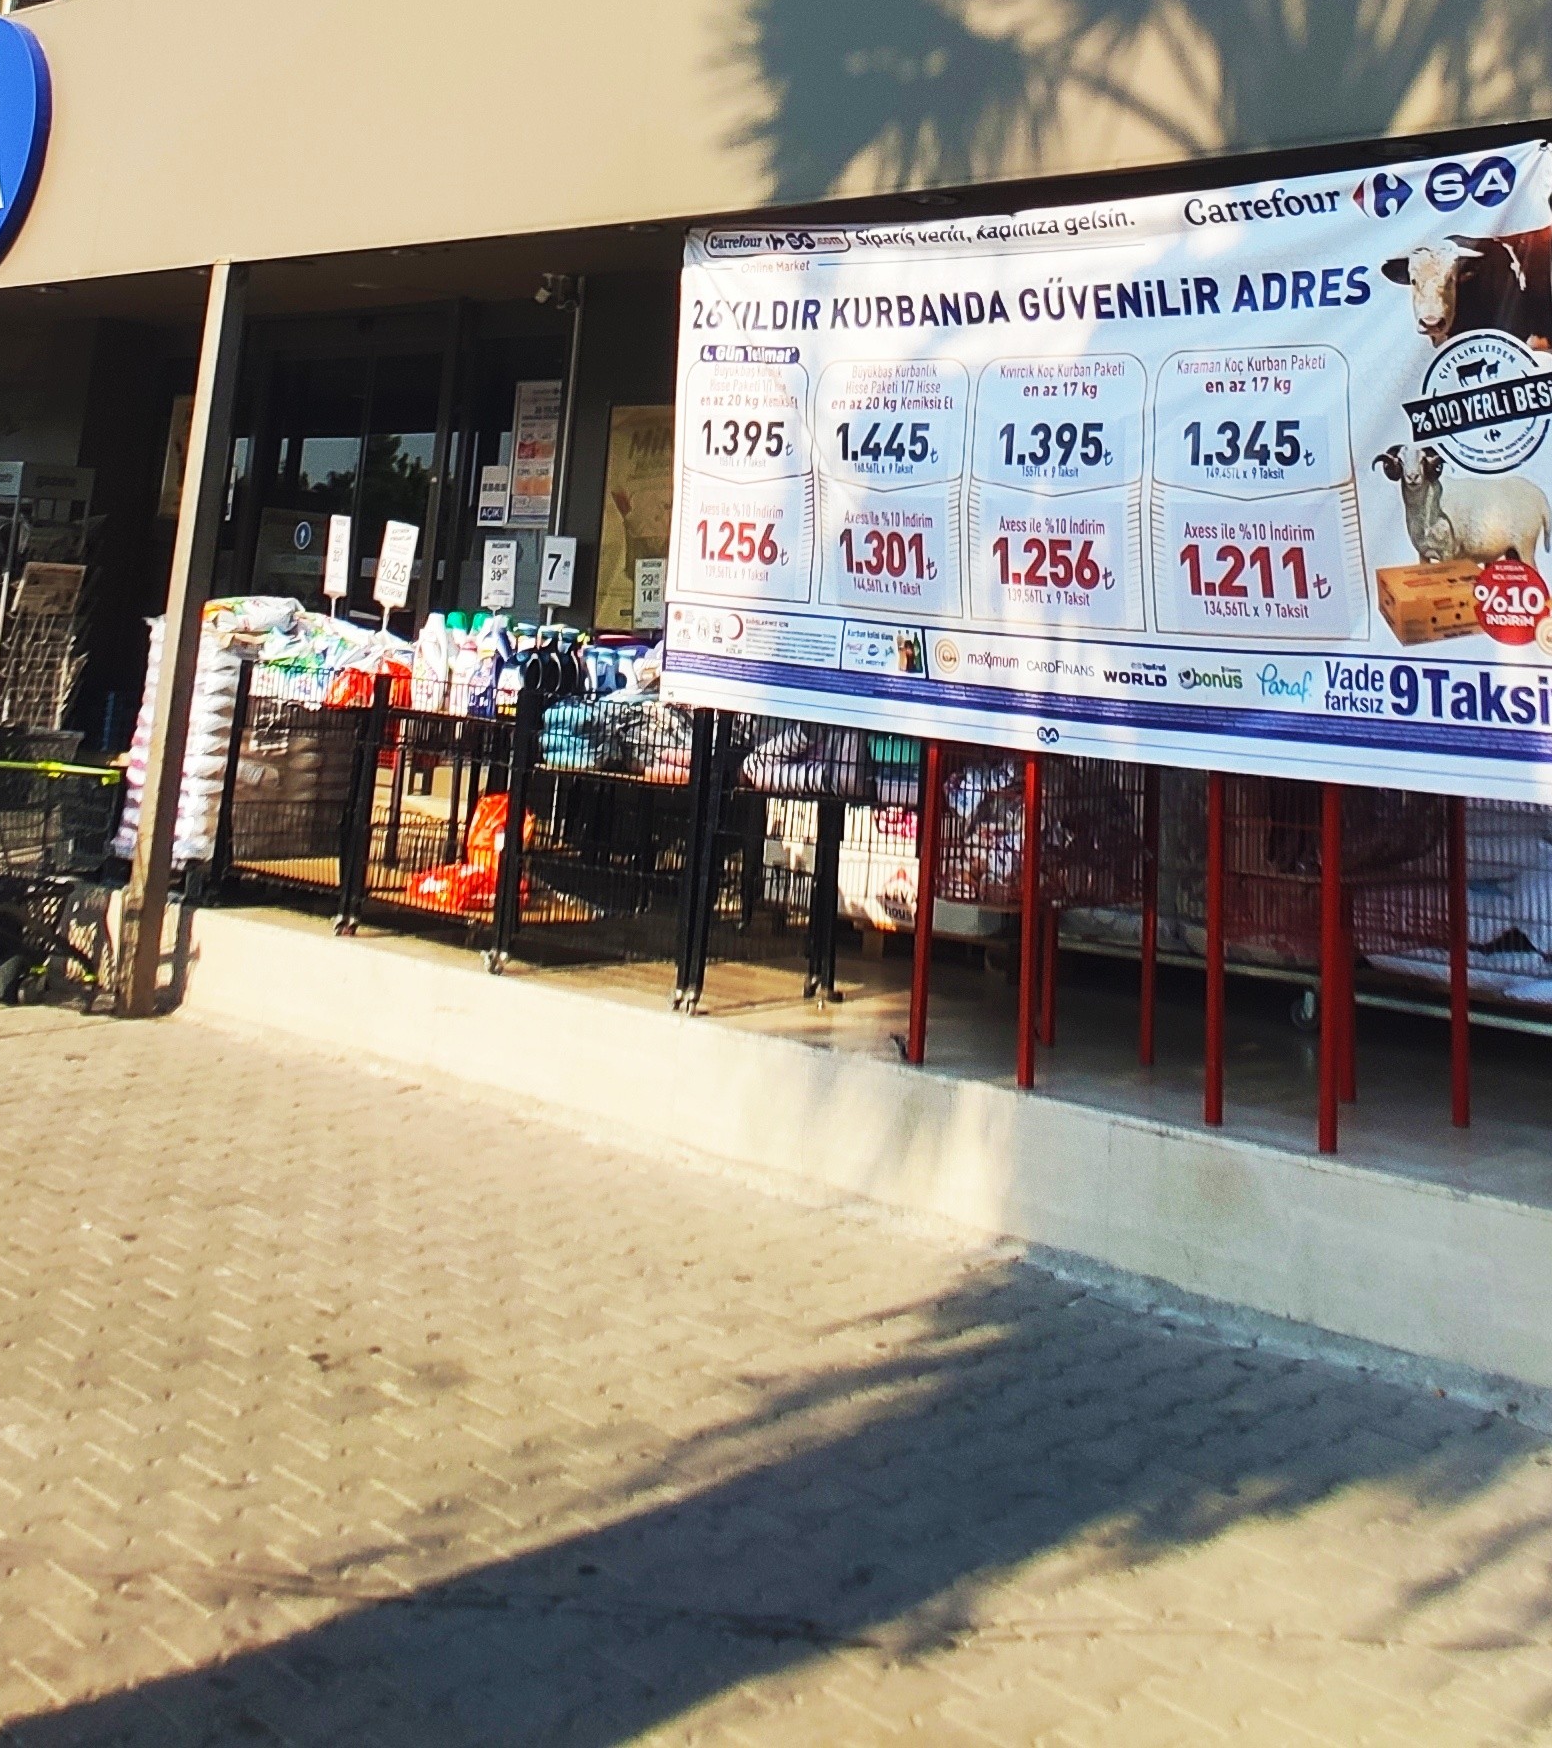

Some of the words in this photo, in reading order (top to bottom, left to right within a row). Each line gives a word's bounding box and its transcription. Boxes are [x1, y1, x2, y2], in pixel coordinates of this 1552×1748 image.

[1184, 188, 1340, 226] Carrefour
[856, 229, 915, 247] Sipariş
[1064, 208, 1135, 236] gelsin.
[710, 231, 762, 249] Carrefour
[776, 260, 810, 272] Market
[830, 290, 1011, 330] KURBANDA
[1231, 265, 1371, 313] ADRES
[716, 347, 744, 361] Gün
[895, 364, 937, 378] Kurbanlık
[1037, 364, 1055, 381] Koç
[1057, 362, 1091, 378] Kurban
[1094, 361, 1125, 377] Paketi
[1176, 358, 1221, 375] Karaman
[1224, 357, 1244, 375] Koç
[1247, 355, 1288, 372] Kurban
[1290, 354, 1326, 370] Paketi
[871, 380, 898, 394] Paketi
[901, 380, 914, 394] 1/7
[917, 380, 941, 394] Hisse
[1023, 383, 1040, 398] en
[1042, 383, 1058, 397] az
[1062, 382, 1078, 396] 17
[1081, 381, 1098, 399] kg
[1205, 379, 1224, 394] en
[1228, 378, 1246, 393] az
[1251, 376, 1270, 393] 17
[1273, 376, 1291, 394] kg
[727, 394, 741, 406] 20
[745, 395, 759, 409] kg
[831, 399, 846, 409] en
[849, 399, 862, 410] az
[865, 397, 880, 410] 20
[883, 396, 897, 413] kg
[900, 396, 941, 410] Kemiksiz
[944, 396, 953, 410] Et
[1412, 402, 1461, 434] %100
[1058, 465, 1079, 478] Taksit
[1252, 467, 1257, 479] 9
[1260, 467, 1284, 479] Taksit
[999, 515, 1027, 534] Axess
[1029, 516, 1042, 534] ile
[1045, 517, 1066, 534] %10
[1069, 516, 1106, 536] İndirim
[1184, 523, 1218, 540] Axess
[1220, 524, 1236, 540] ile
[1238, 524, 1267, 541] %10
[1270, 522, 1315, 542] İndirim
[381, 558, 408, 583] %25
[899, 582, 921, 595] Taksit
[1056, 591, 1062, 605] 9
[1063, 591, 1090, 608] Taksit
[1474, 585, 1545, 615] %10
[1203, 601, 1250, 618] 134,56TL
[1253, 607, 1260, 618] x
[1265, 603, 1272, 618] 9
[1275, 603, 1310, 620] Taksit
[1103, 670, 1168, 688] WORLD
[1192, 666, 1243, 690] bonus
[1325, 660, 1385, 692] Vade
[1390, 665, 1419, 716] 9
[1324, 689, 1385, 715] farksız
